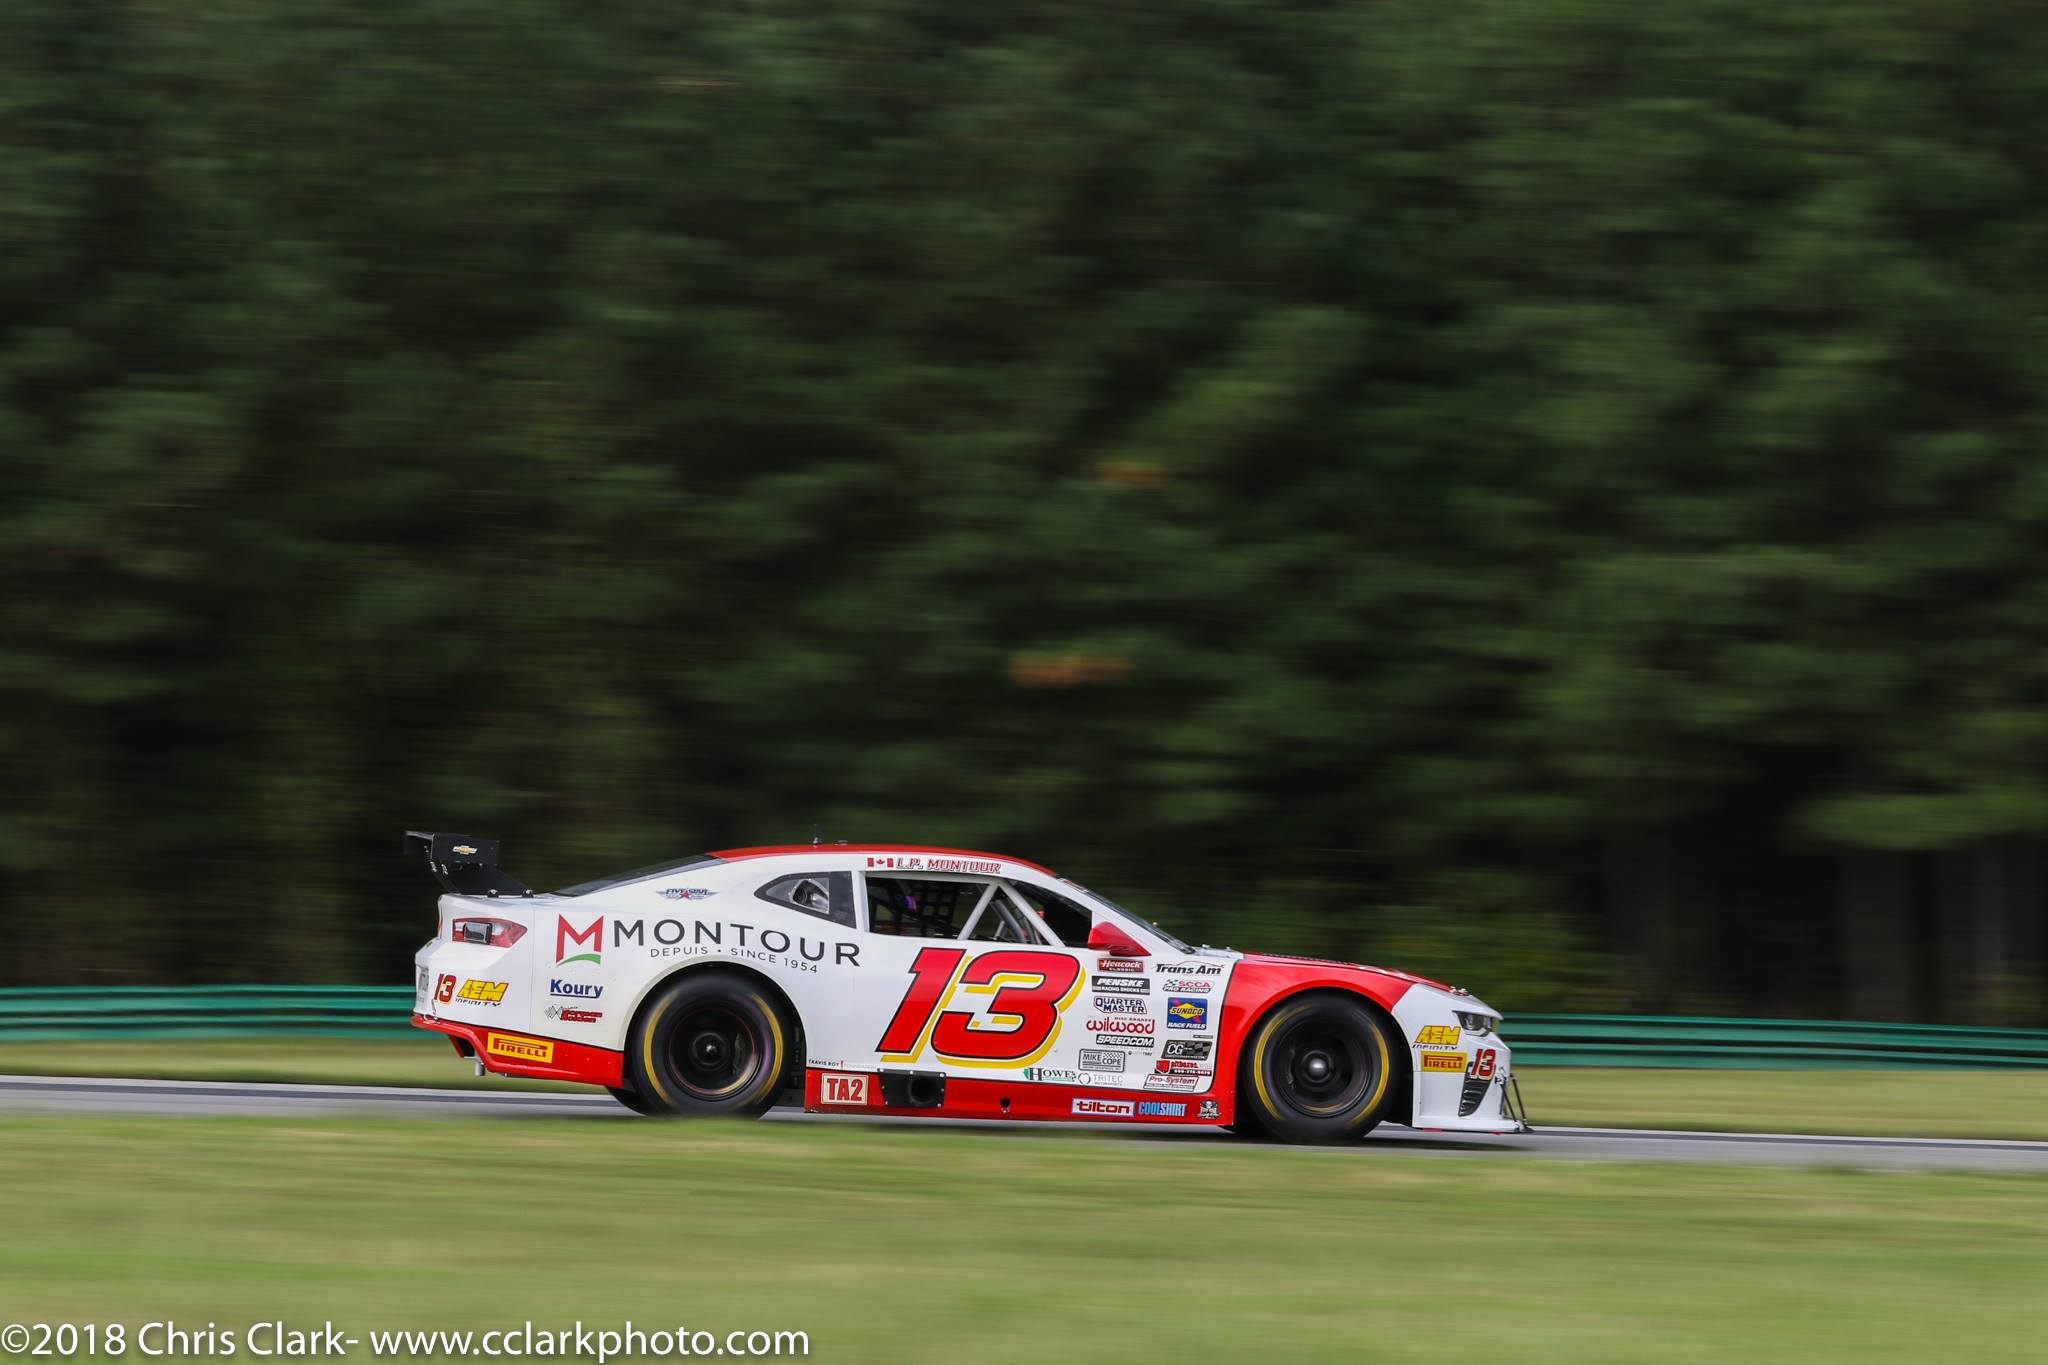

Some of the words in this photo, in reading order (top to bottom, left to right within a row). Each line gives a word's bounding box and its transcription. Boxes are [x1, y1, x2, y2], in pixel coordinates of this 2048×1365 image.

[927, 859, 1001, 874] MONTOUR
[614, 918, 861, 967] MONTOUR
[650, 946, 708, 958] DEPUIS
[730, 948, 776, 964] SINCE
[784, 957, 818, 973] 1954
[1100, 960, 1141, 968] Heacock
[1156, 963, 1195, 974] Trans
[1195, 964, 1221, 975] Am
[434, 973, 457, 1004] 13
[550, 978, 603, 998] Koury
[1096, 978, 1144, 987] PENSKE
[1178, 980, 1211, 988] SCCA
[457, 979, 509, 1002] AEM
[875, 946, 1086, 1069] 13
[1095, 997, 1143, 1007] QUARTER
[1103, 1004, 1145, 1013] MASTER
[1171, 1007, 1203, 1015] SUNOCO
[1086, 1016, 1155, 1035] wilwood
[1096, 1035, 1154, 1047] SPEEDCOM
[1414, 1025, 1461, 1045] AEM
[492, 1037, 548, 1058] PIRELLI
[1167, 1043, 1184, 1055] CG
[1082, 1053, 1101, 1061] MIKE
[1102, 1057, 1122, 1066] COPE
[1423, 1054, 1463, 1069] PIRELLI
[1471, 1048, 1496, 1080] 13
[1029, 1067, 1072, 1081] HOWE
[1093, 1074, 1124, 1083] TRITEC
[1149, 1075, 1195, 1086] Pro-System
[826, 1078, 864, 1101] TA2
[1076, 1101, 1130, 1114] tilton
[1138, 1101, 1188, 1117] COOLSHIRT
